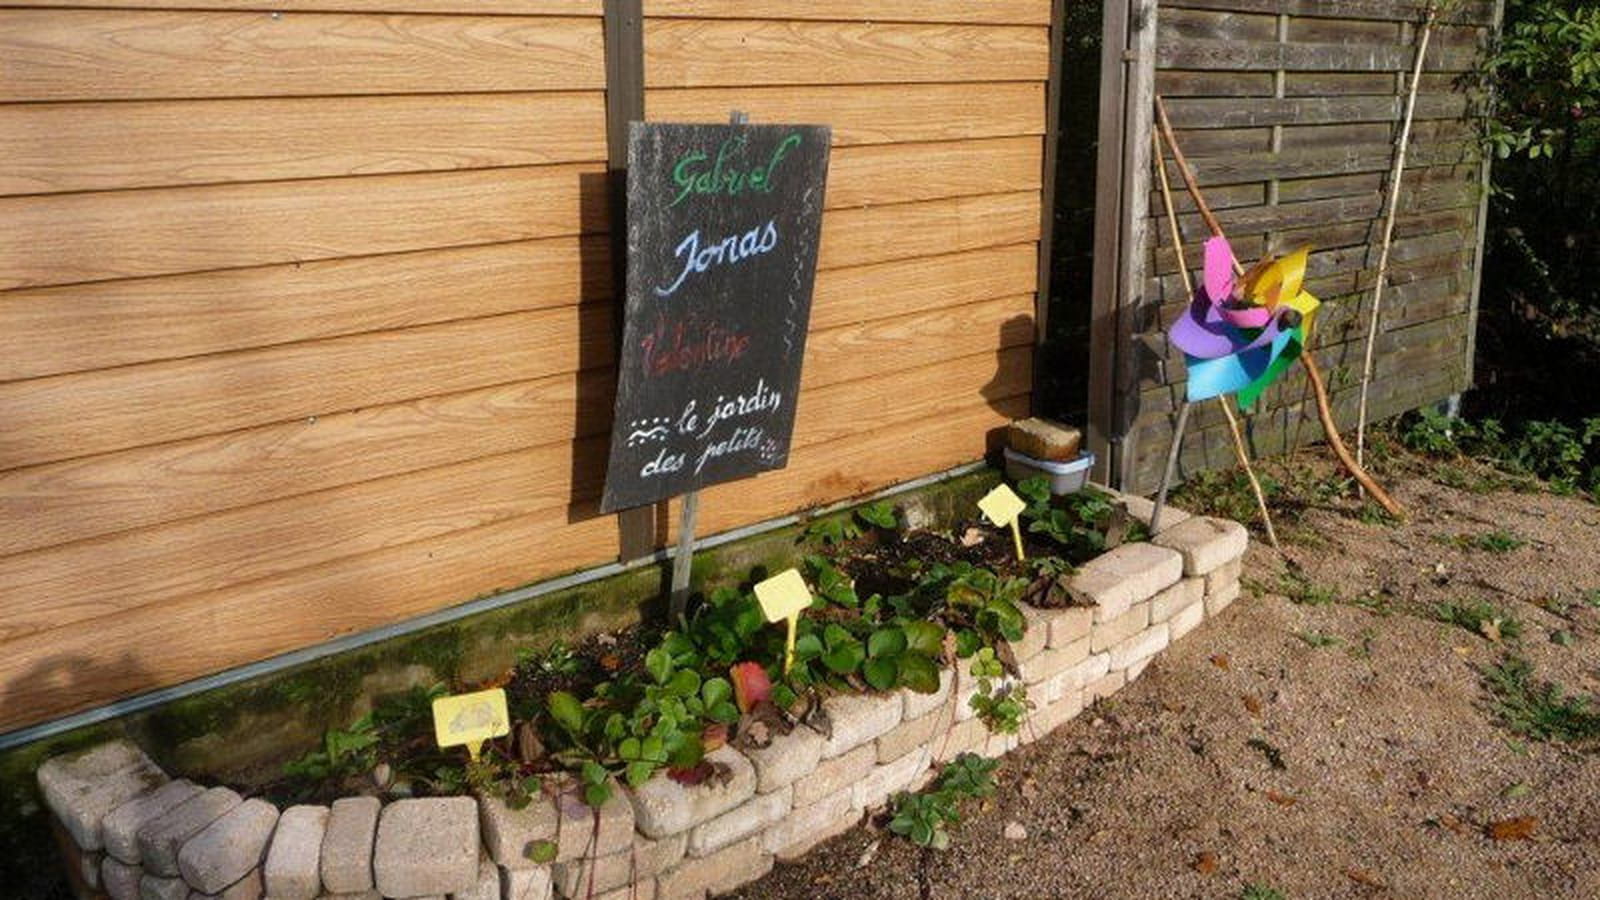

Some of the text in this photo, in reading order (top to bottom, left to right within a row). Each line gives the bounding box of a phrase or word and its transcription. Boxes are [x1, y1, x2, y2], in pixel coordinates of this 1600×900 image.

[669, 133, 802, 207] Gabriel
[656, 219, 778, 296] Jonas
[674, 378, 782, 440] le jardin
[640, 427, 762, 477] des petits
